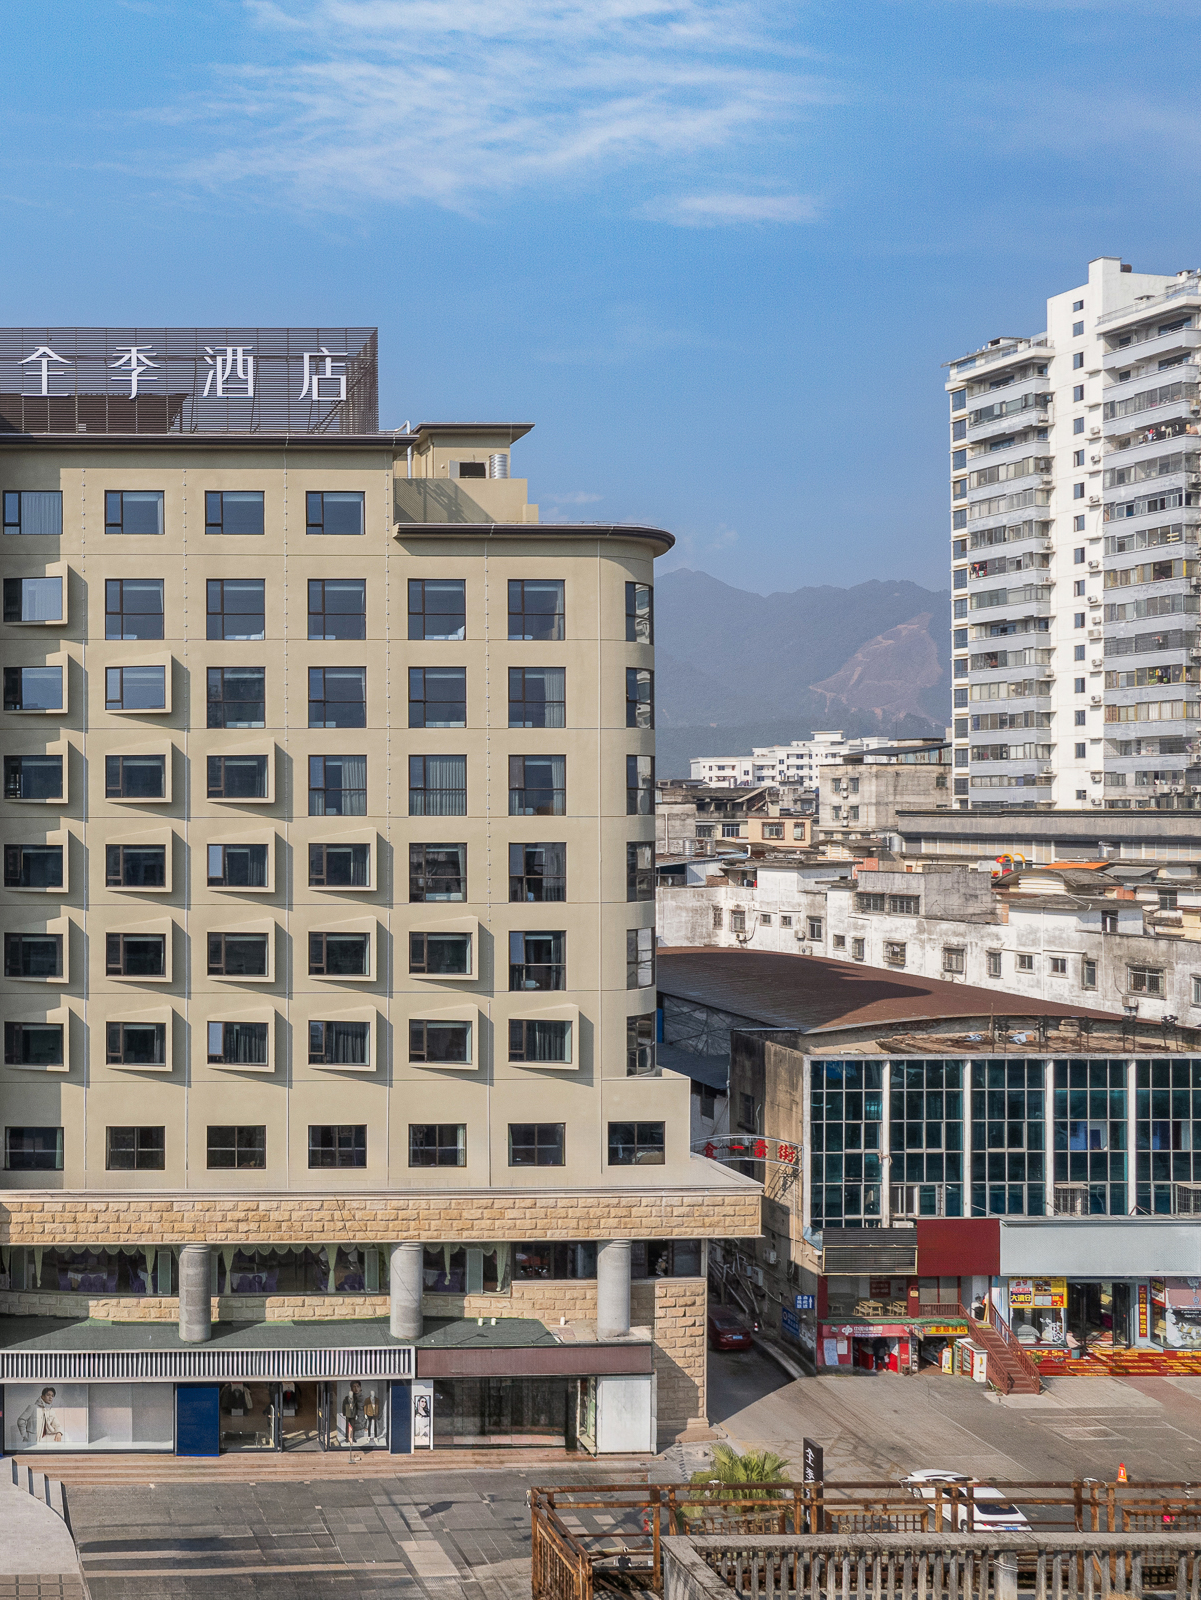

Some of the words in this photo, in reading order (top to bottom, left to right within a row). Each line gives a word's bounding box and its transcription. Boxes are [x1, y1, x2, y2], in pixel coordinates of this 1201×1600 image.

[17, 345, 349, 401] 全季酒店
[703, 1139, 796, 1163] 食一条街
